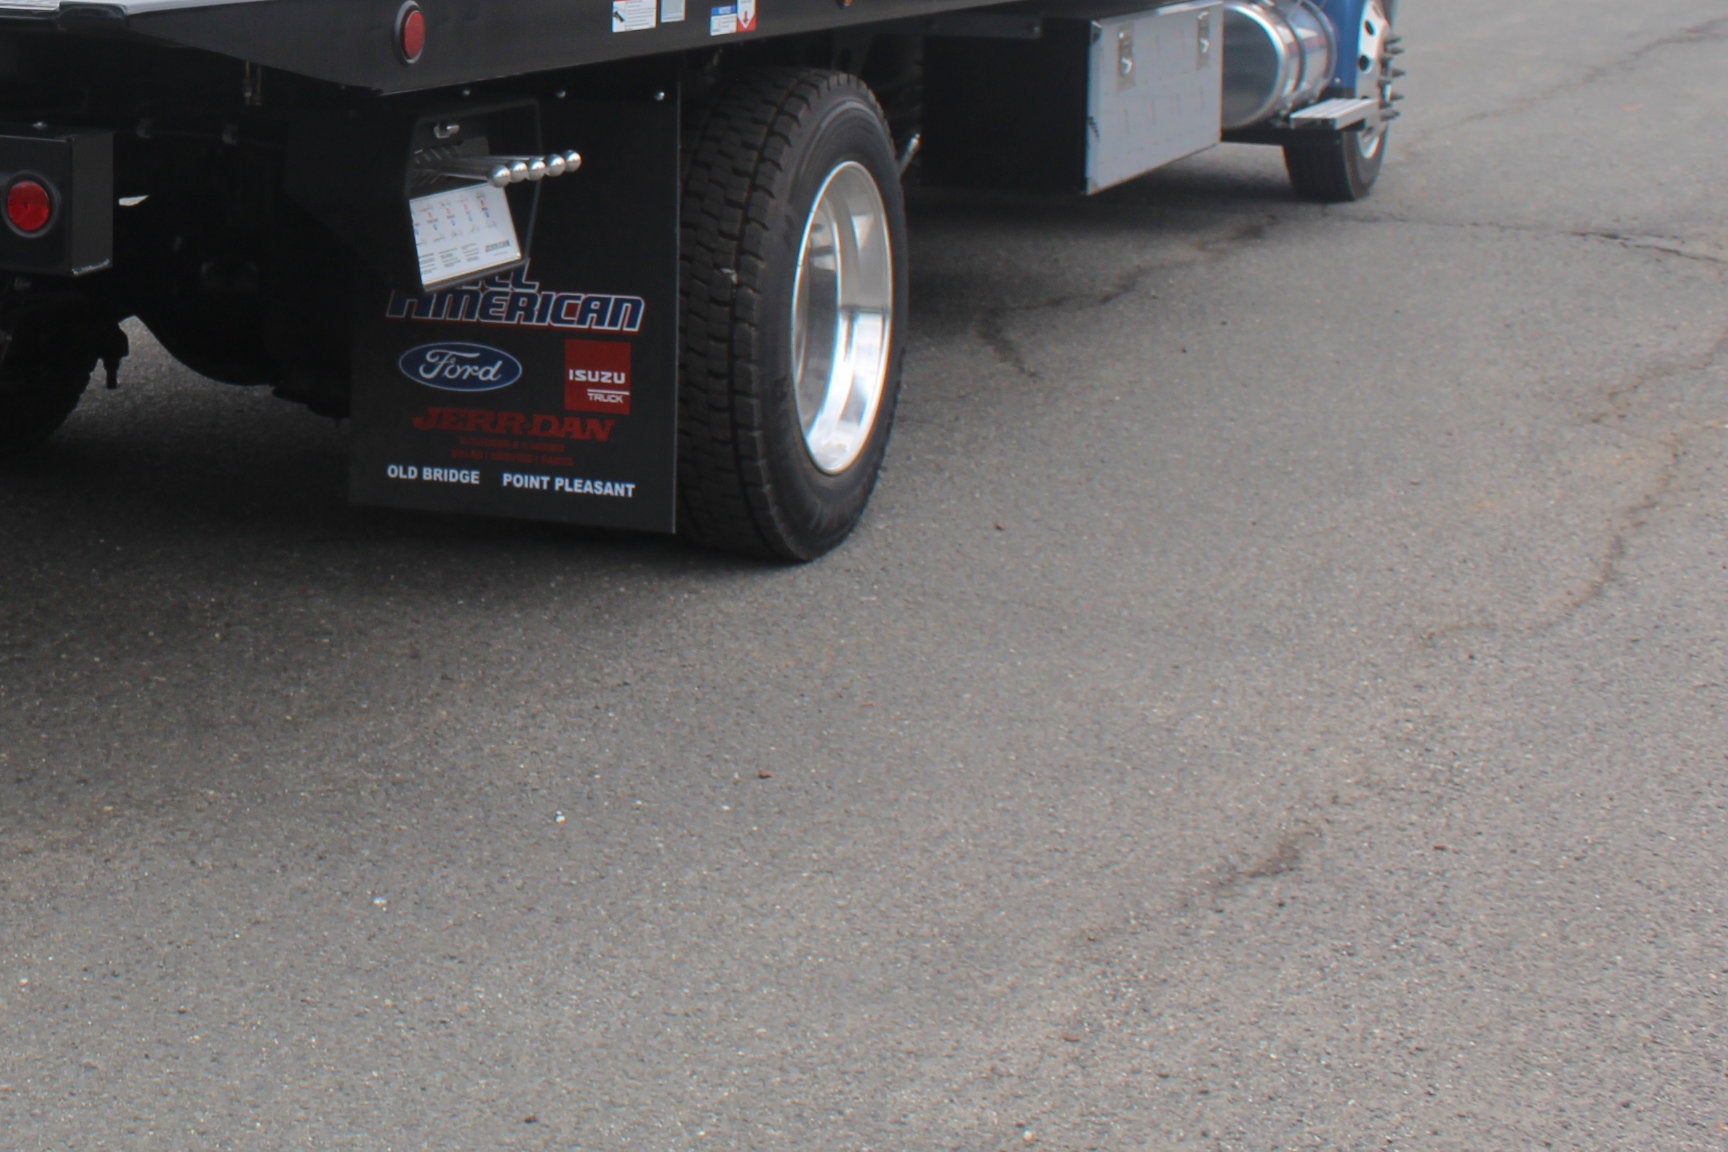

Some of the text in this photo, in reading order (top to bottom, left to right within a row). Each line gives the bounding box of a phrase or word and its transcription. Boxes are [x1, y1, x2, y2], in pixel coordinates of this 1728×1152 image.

[418, 348, 504, 382] Ford
[568, 368, 627, 385] ISUZU
[587, 392, 624, 404] TRUCK
[386, 463, 637, 498] OLD BRIDGE POINT PLEASANT
